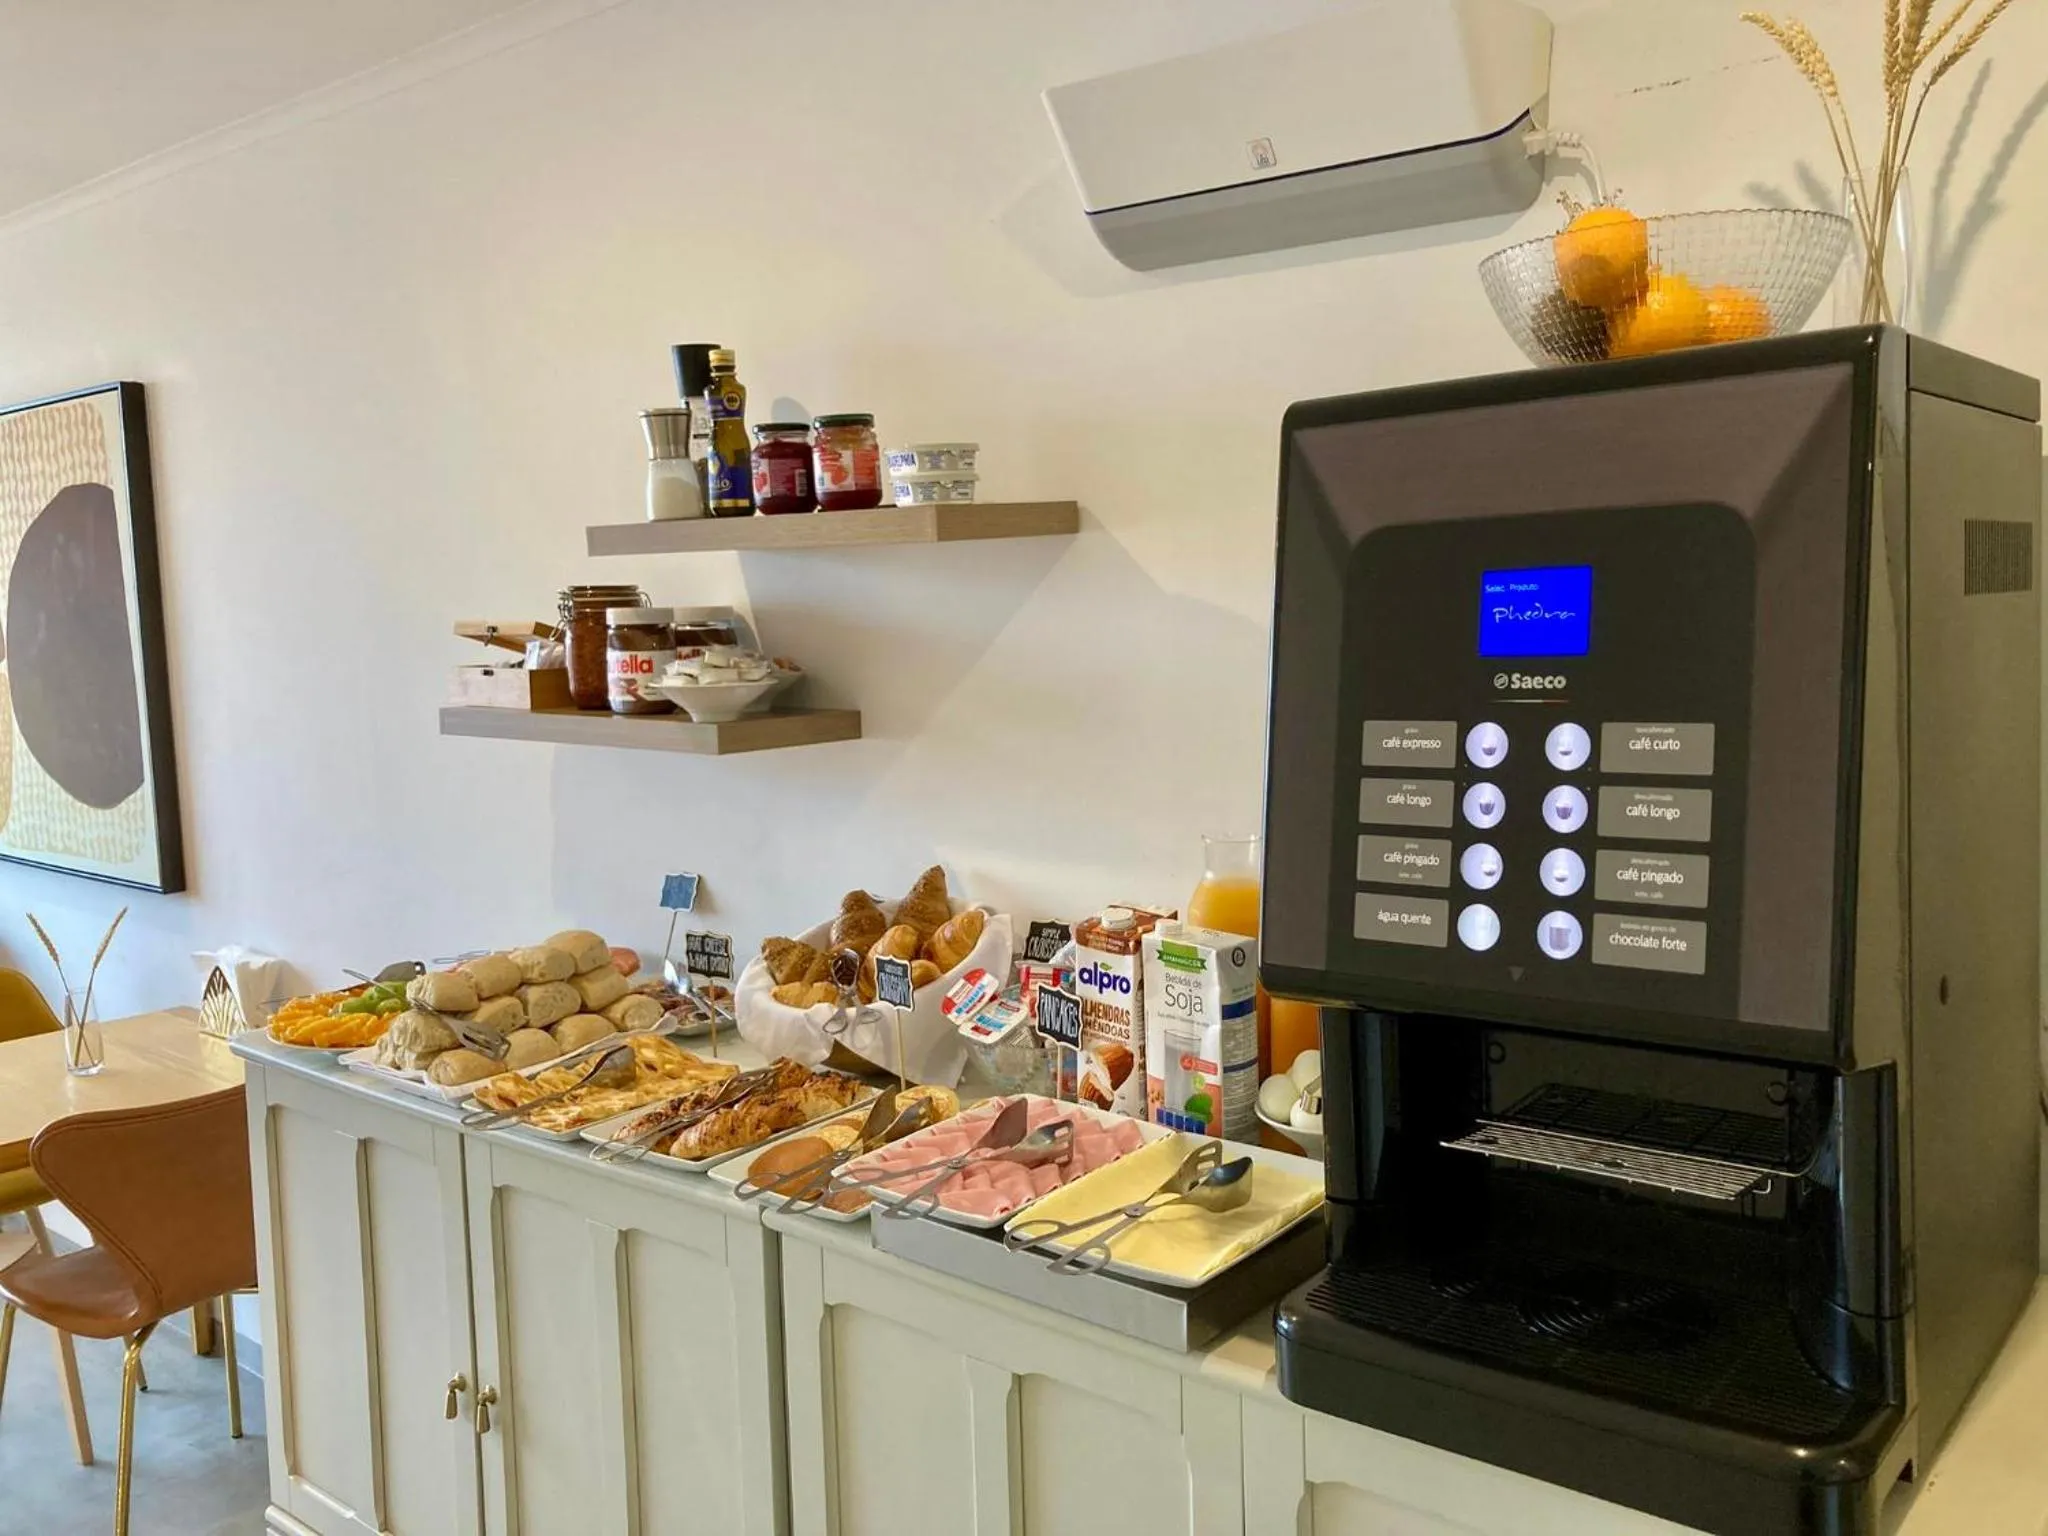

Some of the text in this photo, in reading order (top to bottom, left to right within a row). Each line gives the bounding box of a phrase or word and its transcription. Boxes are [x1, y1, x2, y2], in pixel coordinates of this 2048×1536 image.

[1510, 672, 1567, 689] Saeco
[1382, 736, 1442, 750] café expresso
[1628, 736, 1680, 750] café curto
[1386, 793, 1432, 807] café longo
[1626, 804, 1680, 820] café longo
[1383, 851, 1440, 867] café pingado
[1616, 866, 1684, 885] café pingado
[1377, 908, 1432, 925] água quente
[1609, 932, 1687, 951] chocolate forte
[1078, 961, 1131, 995] alpro
[1164, 984, 1203, 1016] Soja
[1083, 999, 1130, 1027] LMENDRAS
[1084, 1017, 1130, 1039] MÊNDOAS
